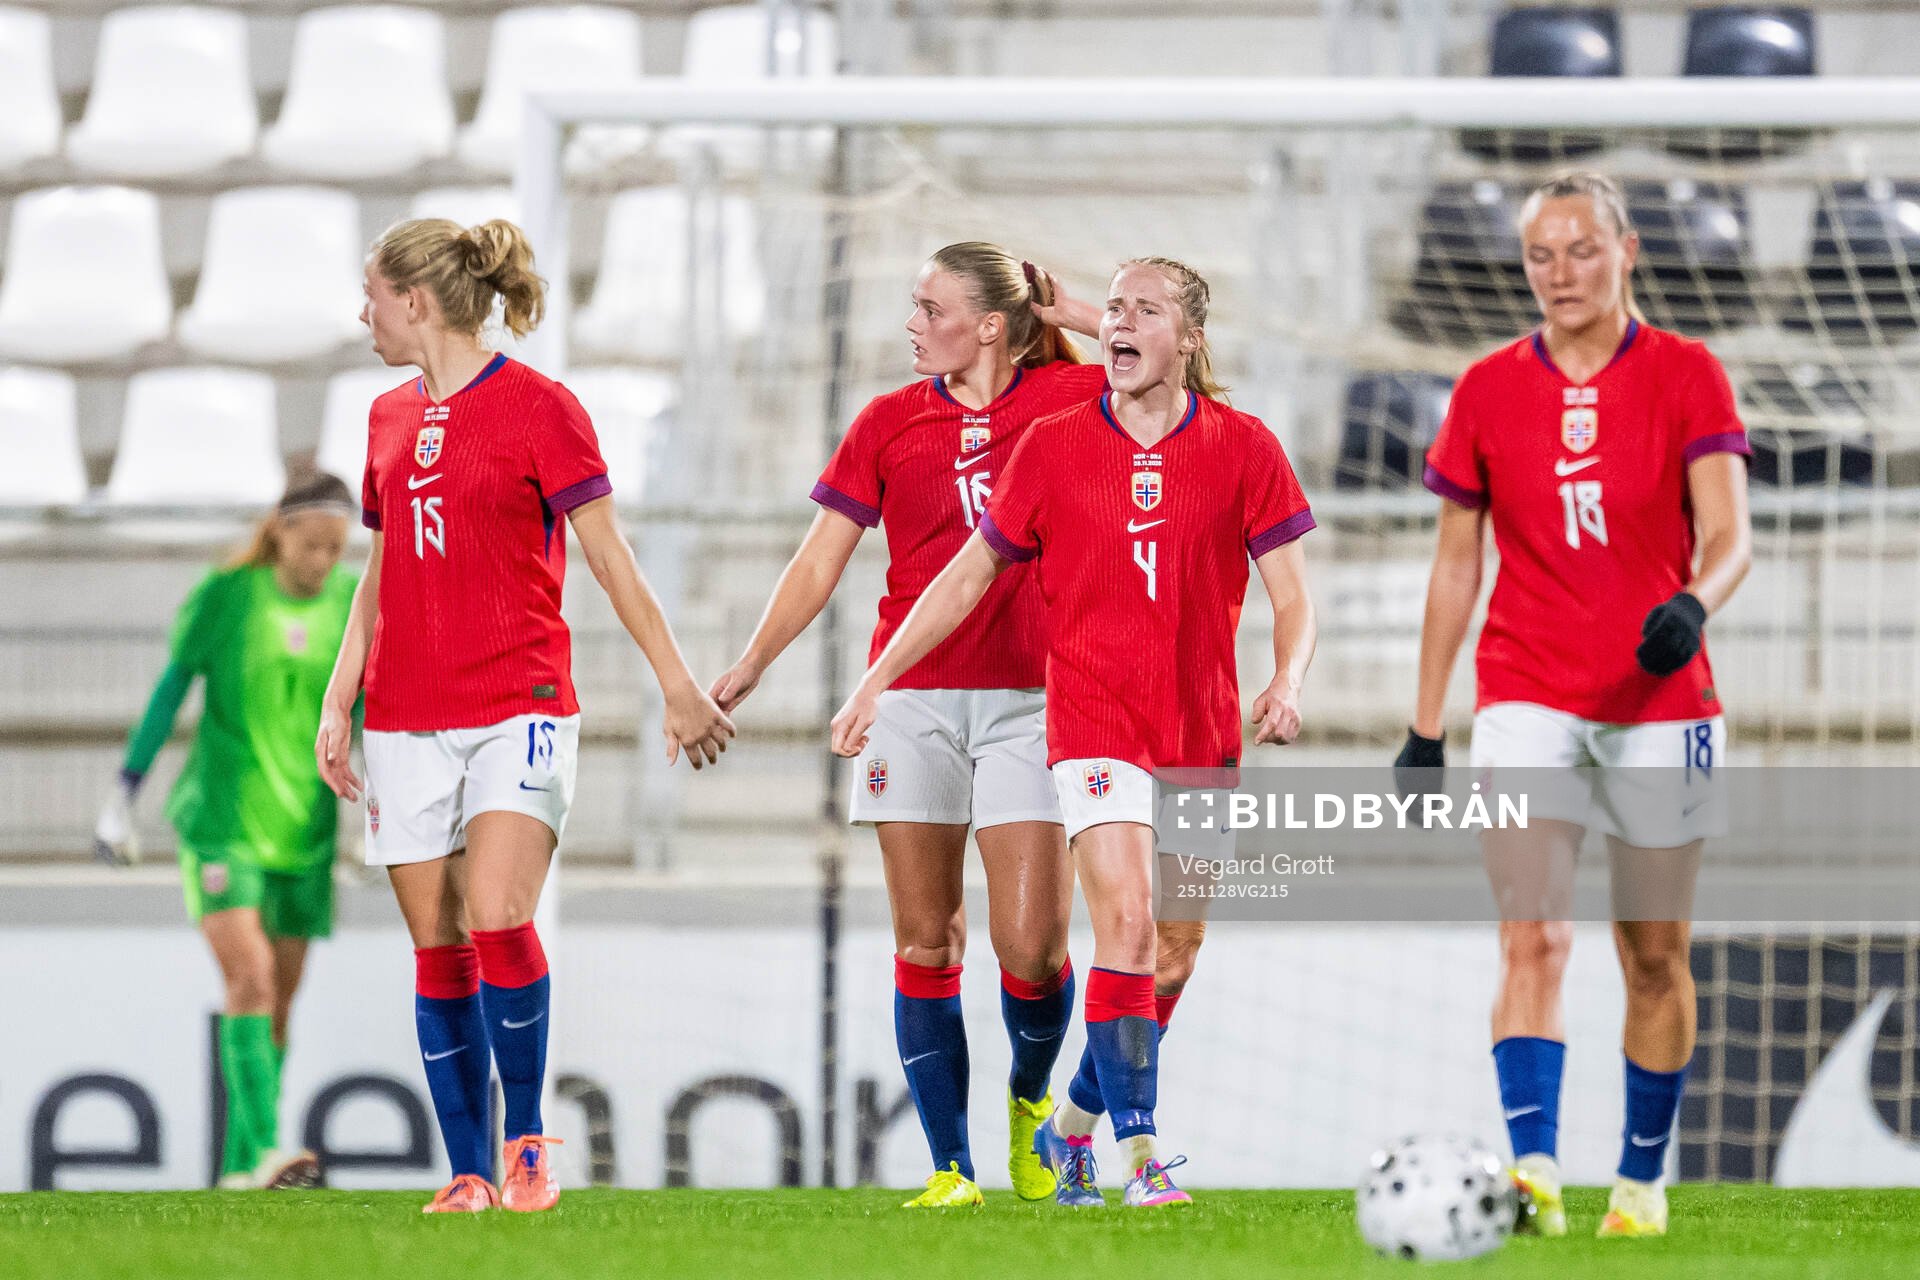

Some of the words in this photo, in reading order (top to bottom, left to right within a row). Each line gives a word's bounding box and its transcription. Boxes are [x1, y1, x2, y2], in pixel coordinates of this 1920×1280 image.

[410, 496, 446, 560] 15
[954, 471, 992, 530] 16
[1558, 479, 1608, 550] 18
[1133, 541, 1157, 602] 4
[527, 720, 556, 768] 15
[1684, 722, 1713, 785] 18
